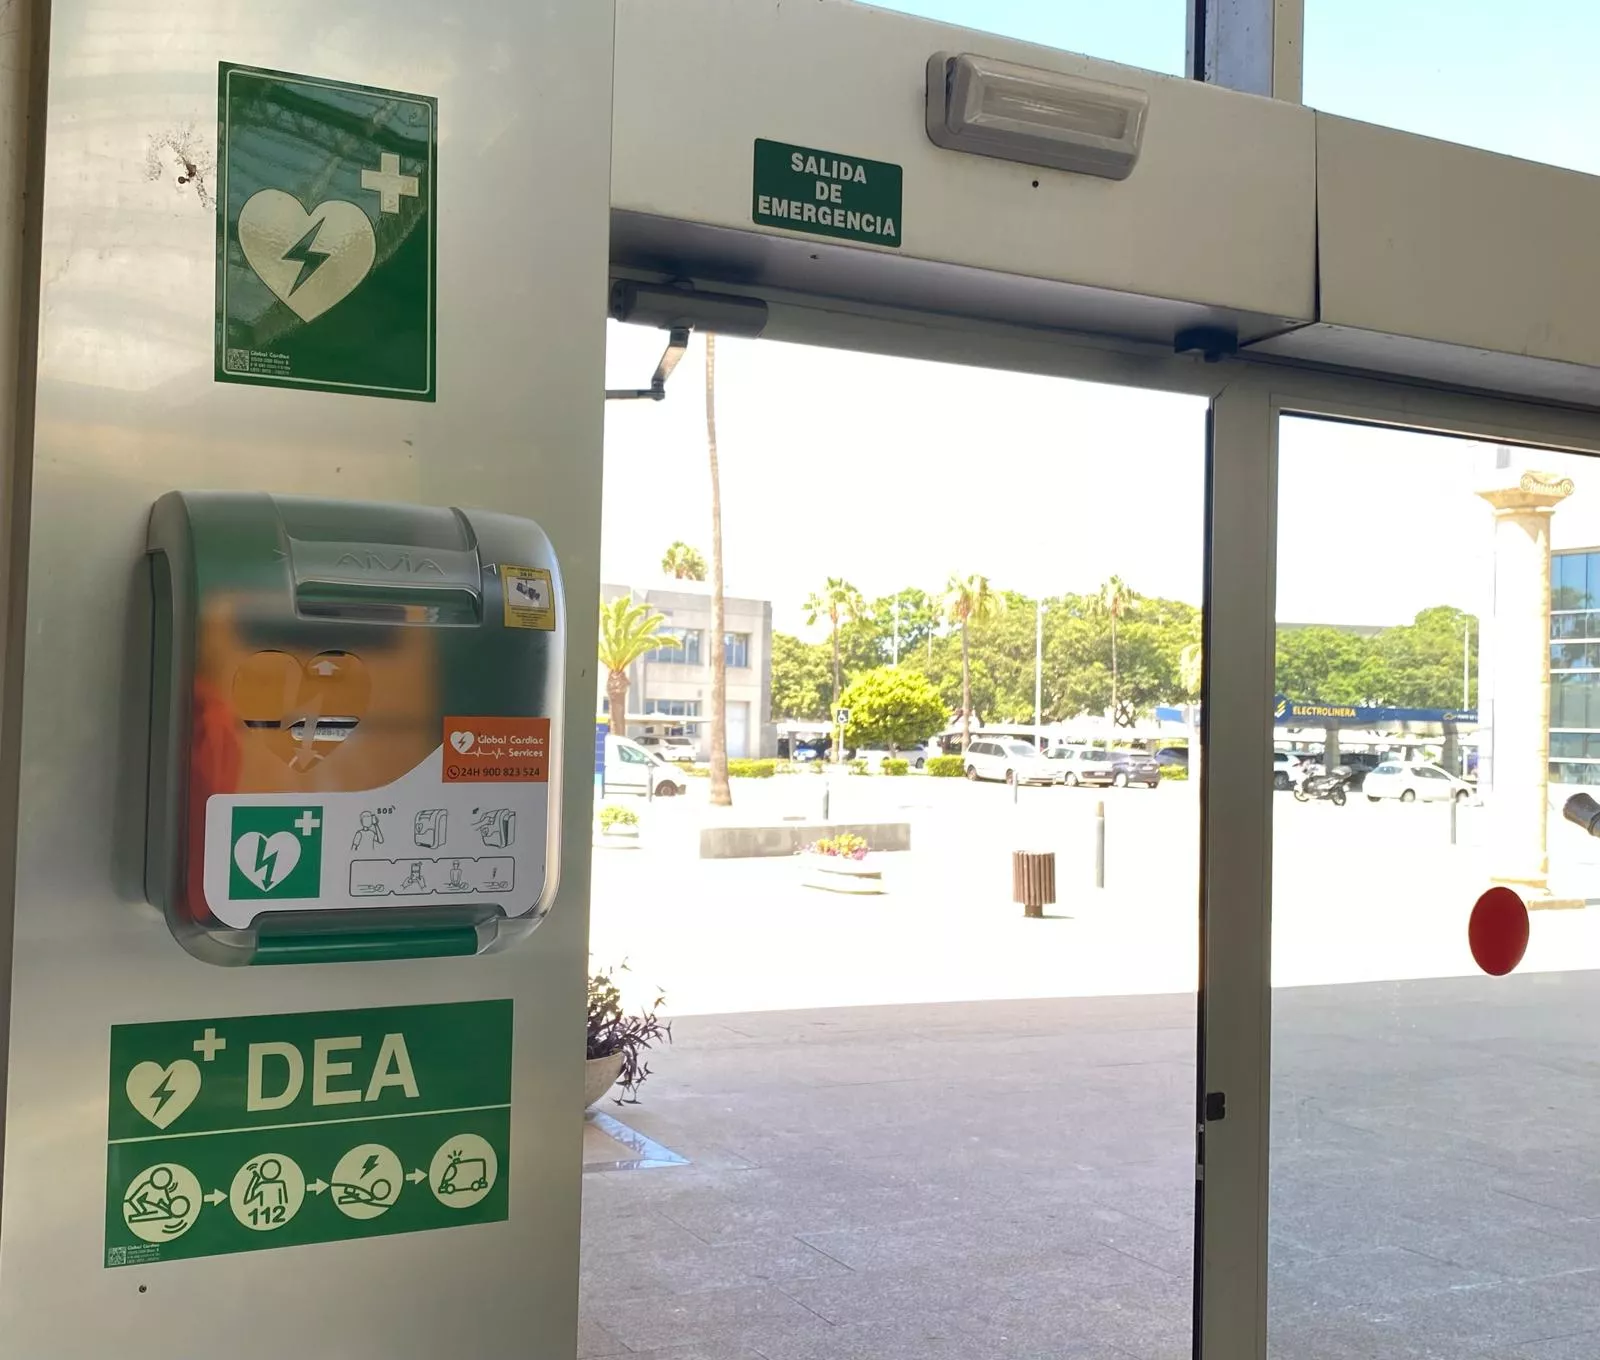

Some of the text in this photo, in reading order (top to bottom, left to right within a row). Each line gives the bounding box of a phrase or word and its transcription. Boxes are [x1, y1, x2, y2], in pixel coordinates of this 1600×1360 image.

[791, 152, 867, 184] SALIDA
[816, 181, 842, 204] DE
[758, 195, 896, 237] EMERGENCIA
[1292, 706, 1356, 717] ELECTROLINERA
[478, 735, 544, 745] Global Cardiac
[508, 748, 544, 757] Services
[461, 767, 540, 777] 24H 900 823 524
[377, 807, 393, 815] SOS
[246, 1033, 420, 1112] DEA
[248, 1205, 286, 1226] 112
